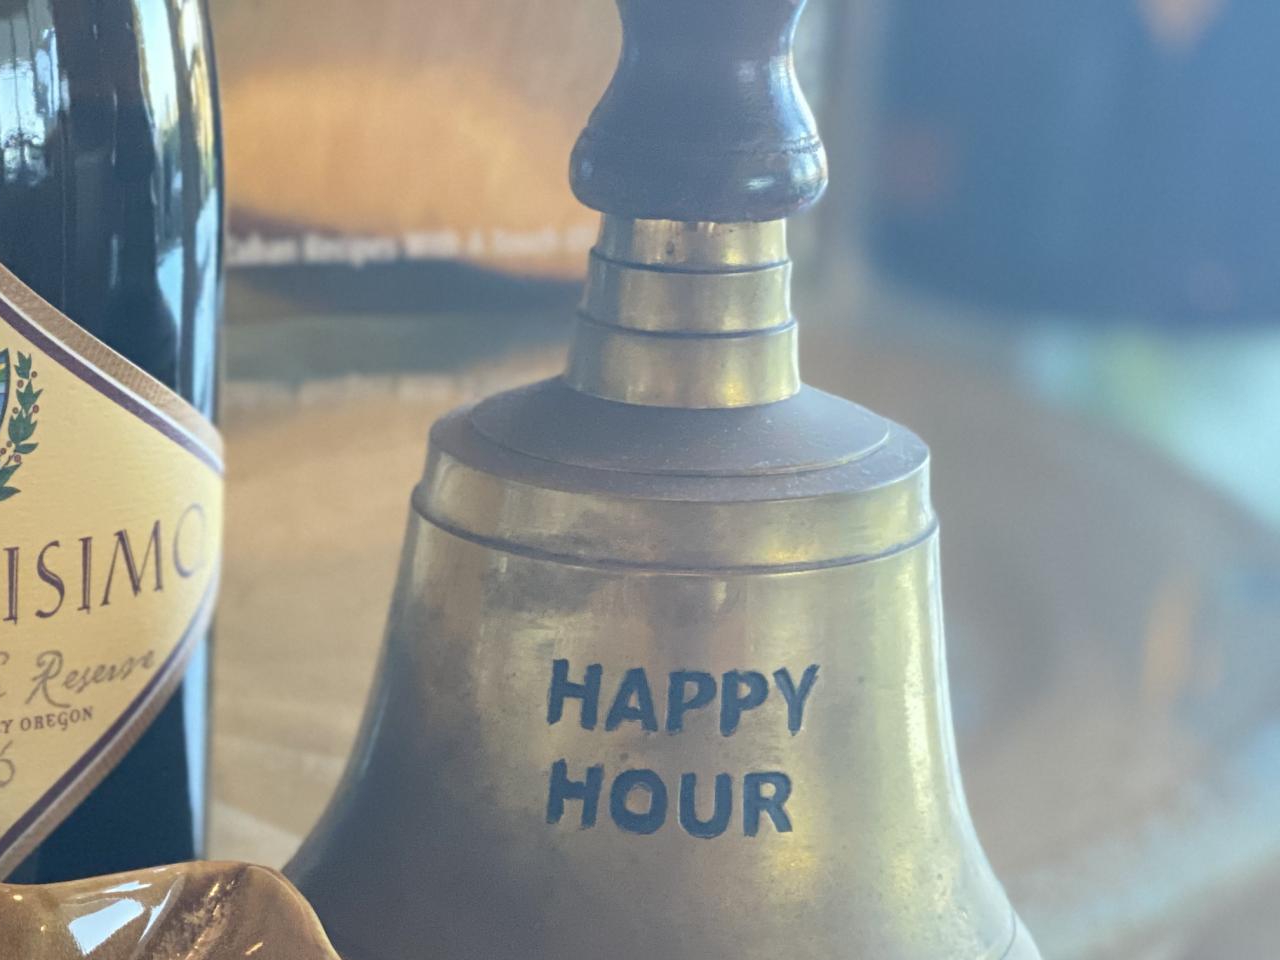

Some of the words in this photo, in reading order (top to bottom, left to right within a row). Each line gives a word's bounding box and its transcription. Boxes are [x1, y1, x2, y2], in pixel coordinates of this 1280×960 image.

[24, 650, 156, 709] Reserve
[546, 658, 821, 737] HAPPY
[20, 706, 94, 732] OREGON
[546, 758, 793, 839] HOUR
